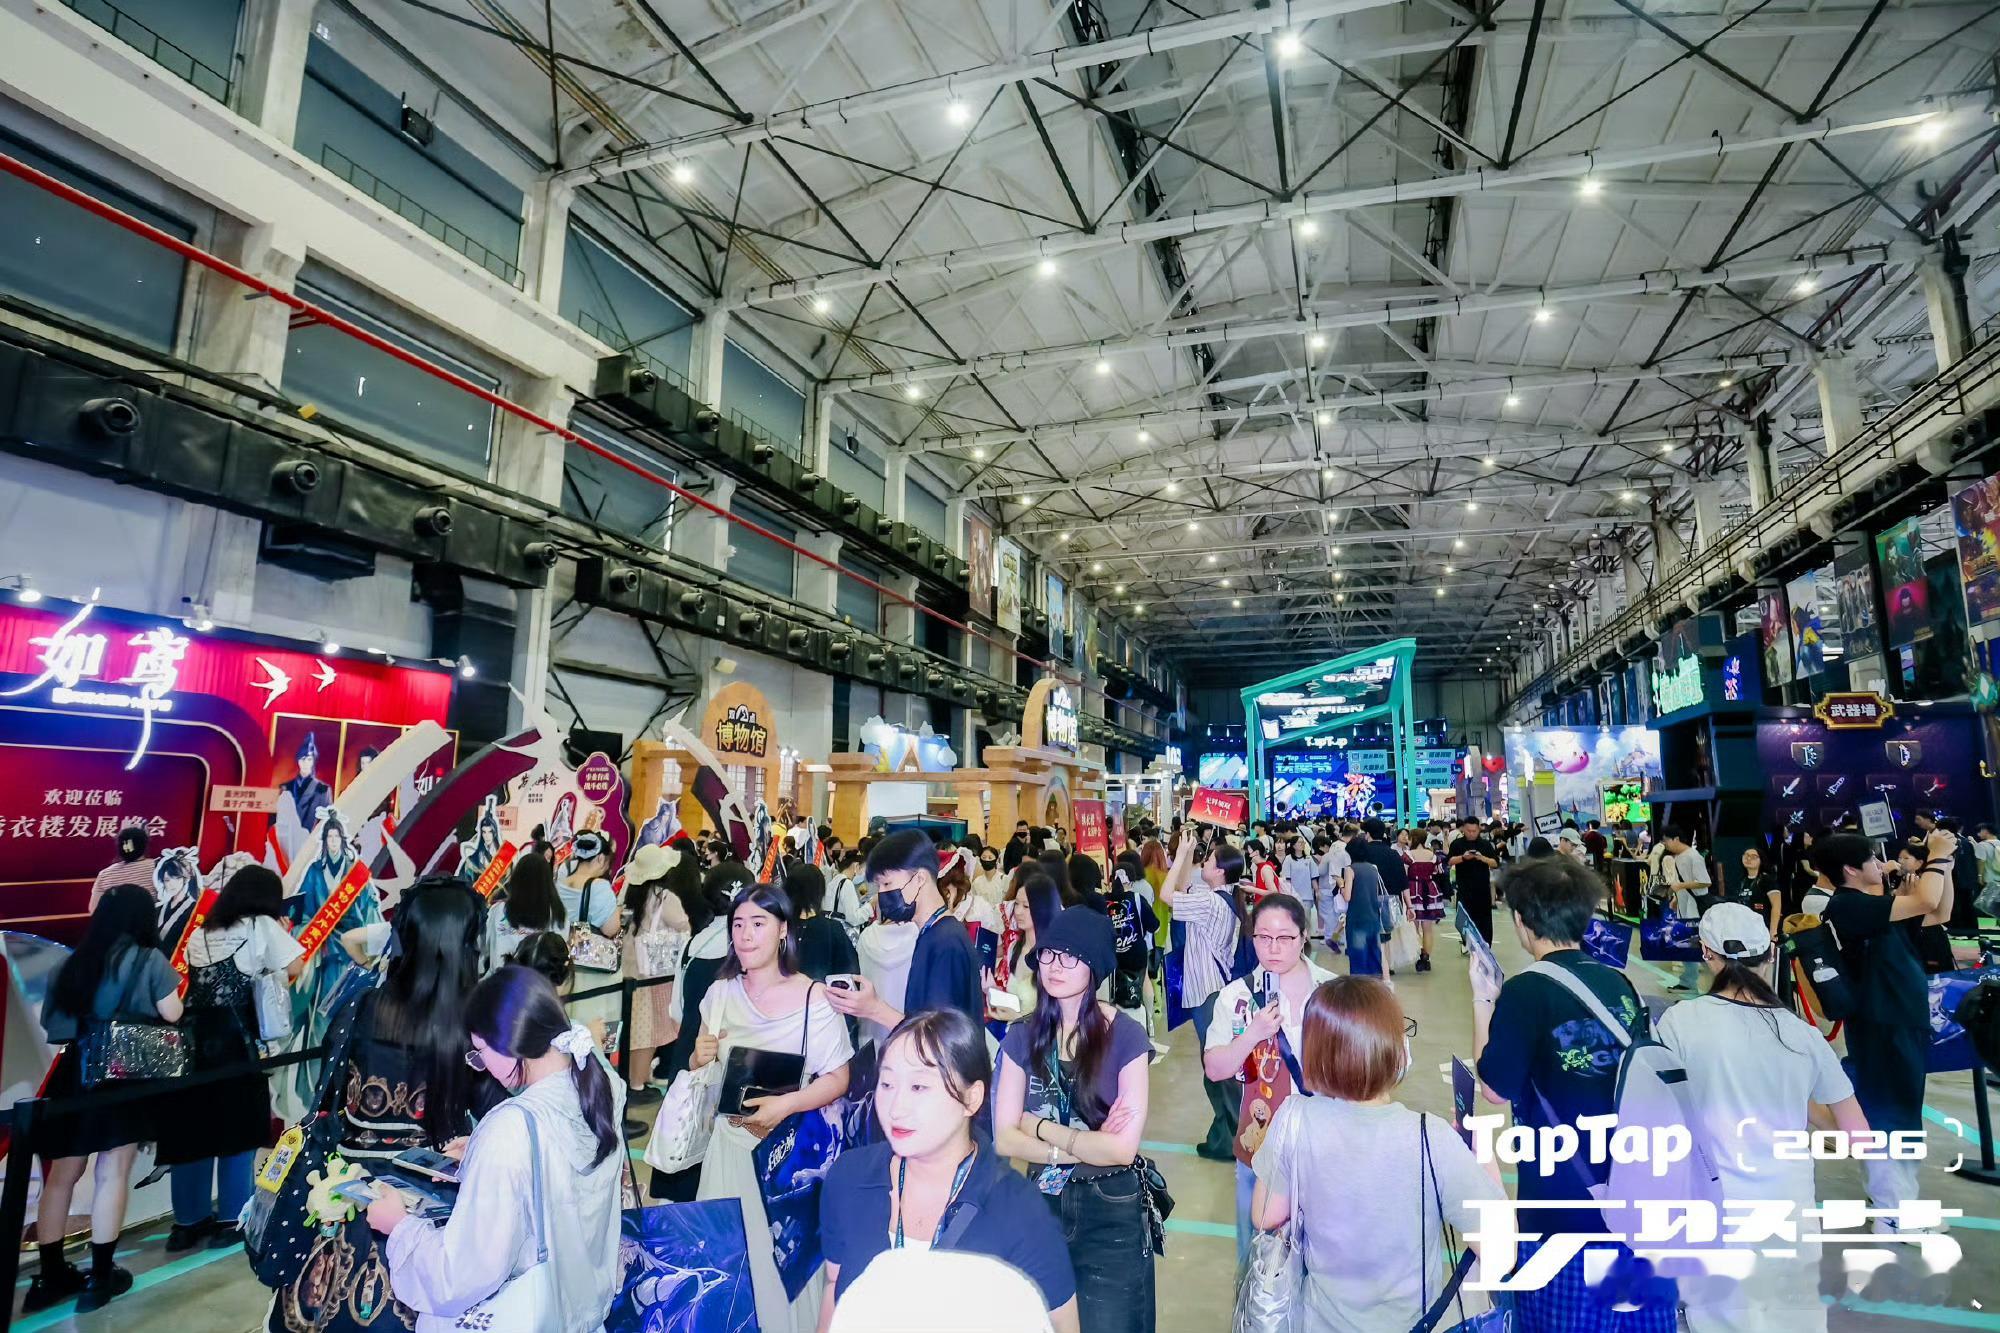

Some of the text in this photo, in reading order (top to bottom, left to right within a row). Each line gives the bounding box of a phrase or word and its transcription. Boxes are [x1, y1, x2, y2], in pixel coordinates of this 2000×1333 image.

[717, 721, 767, 756] 博物馆
[1304, 736, 1348, 749] TapTap
[43, 789, 123, 806] 欢迎莅临
